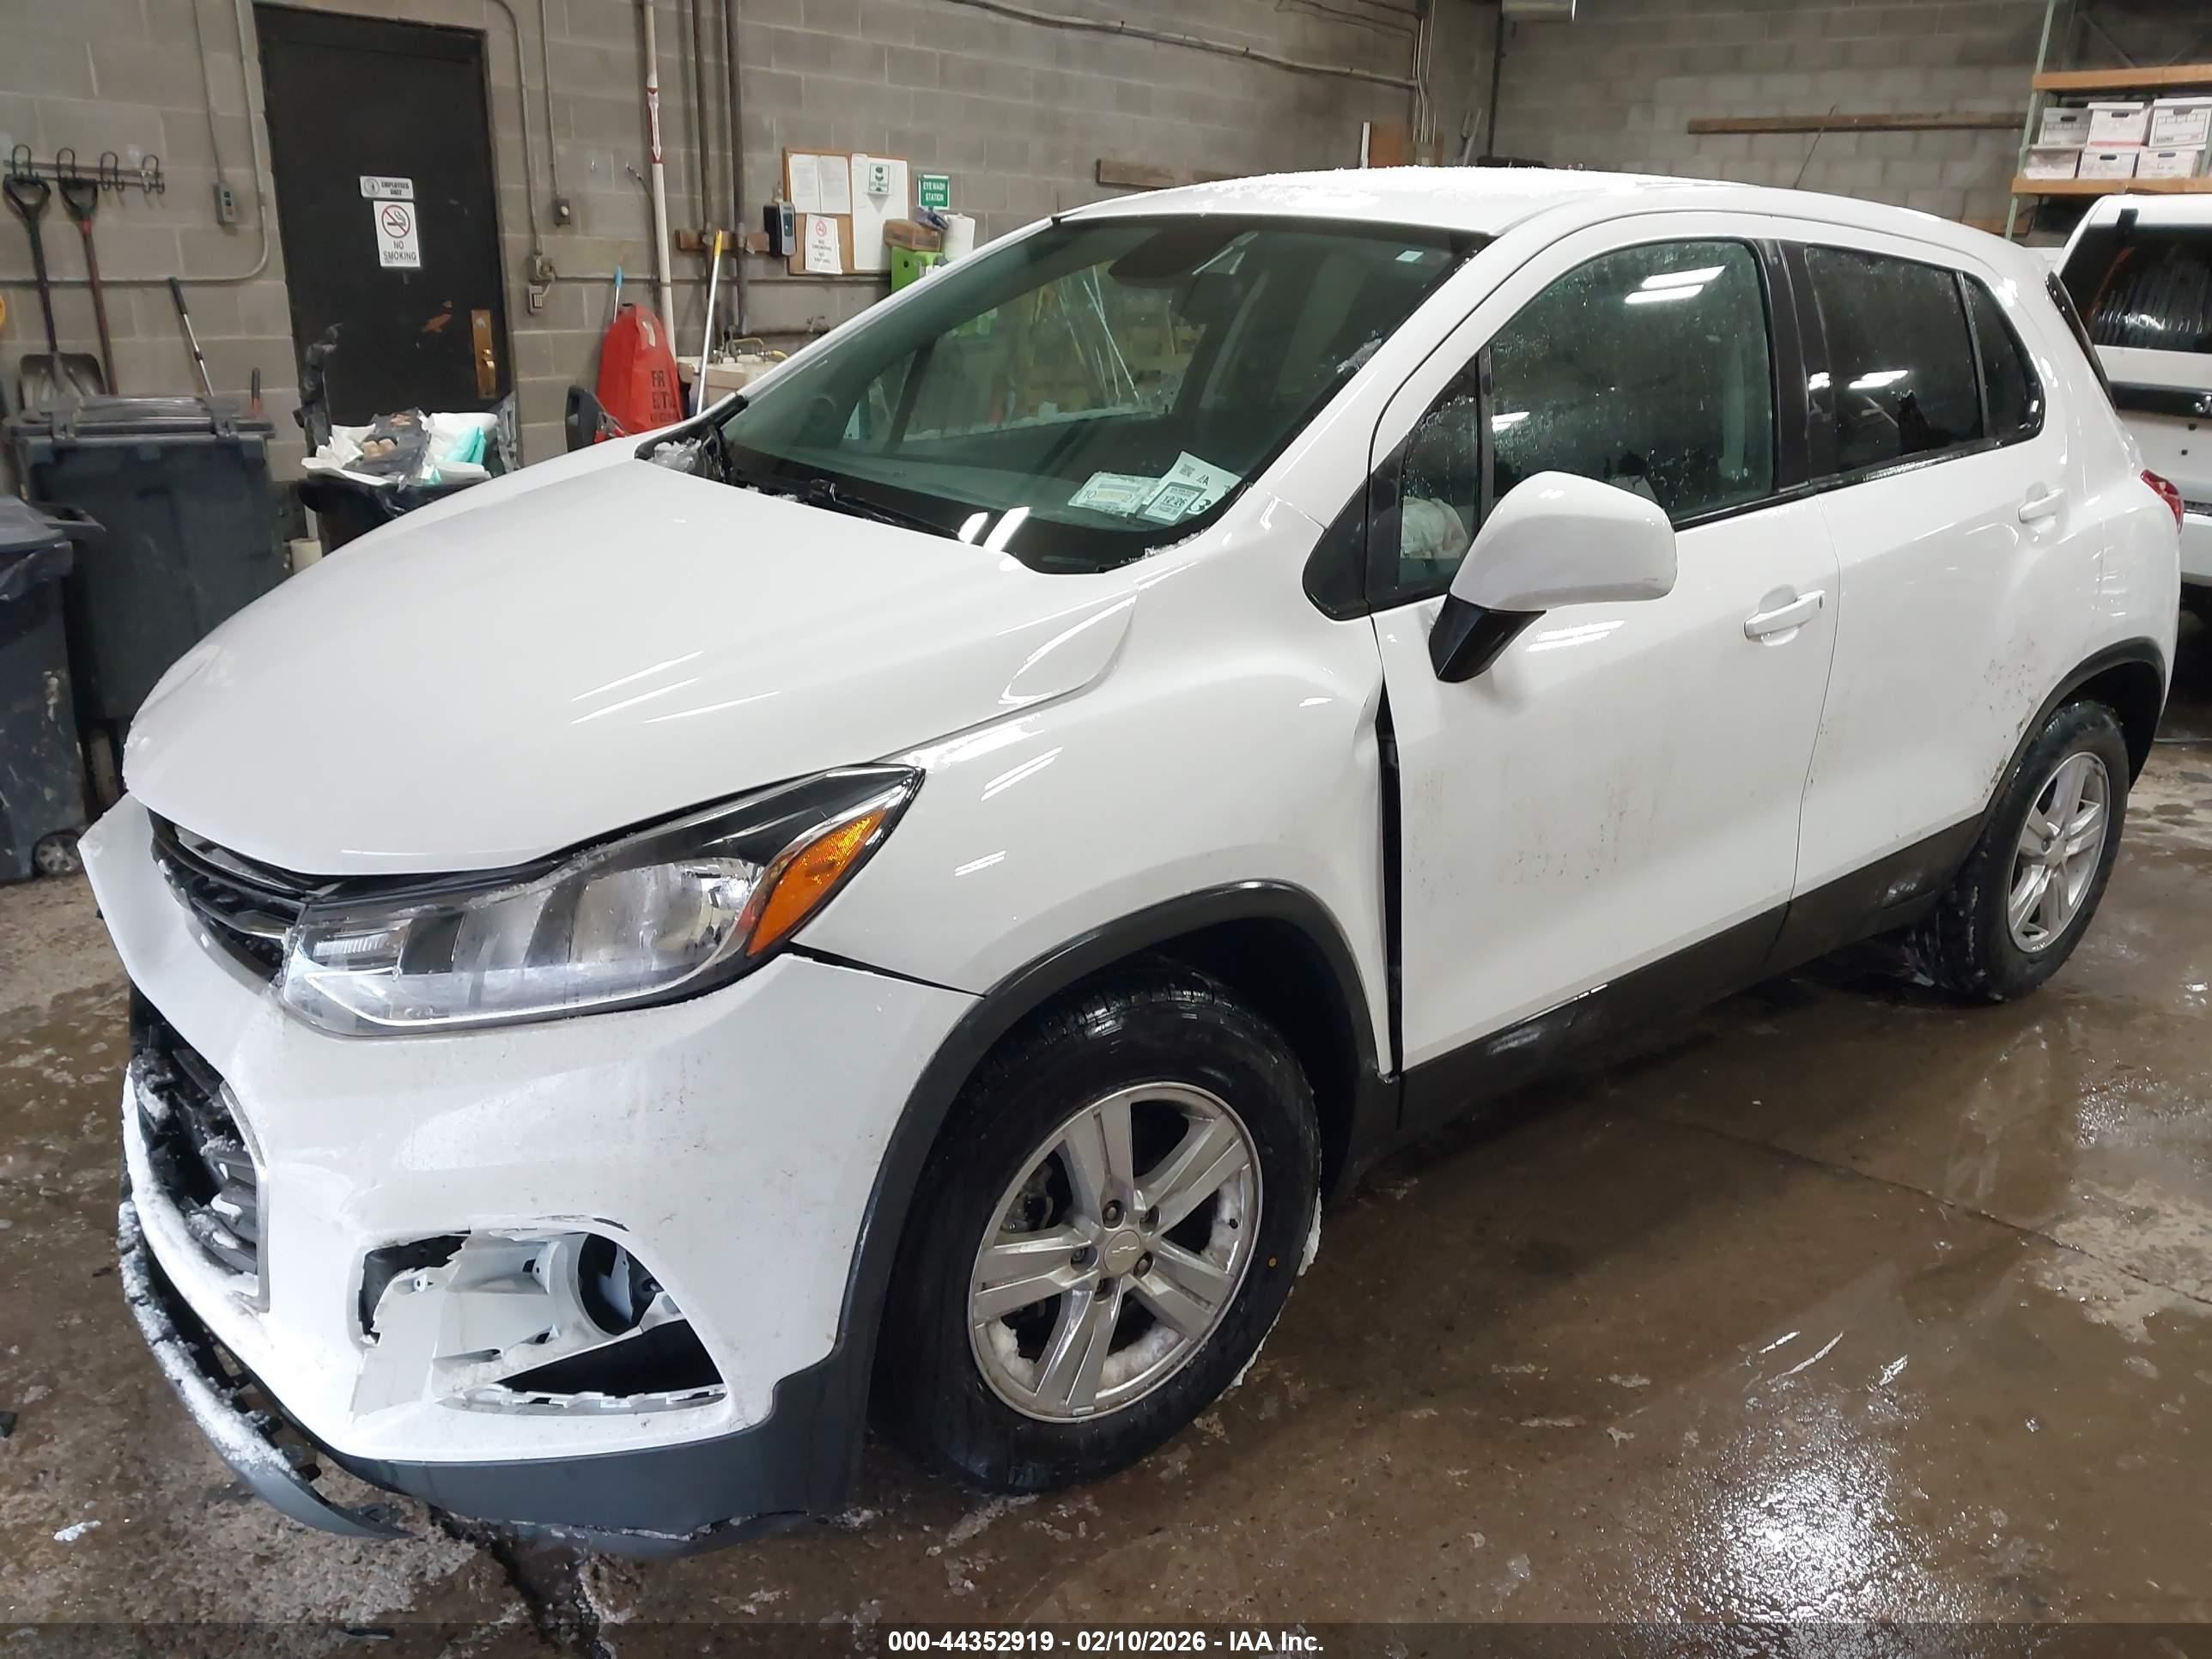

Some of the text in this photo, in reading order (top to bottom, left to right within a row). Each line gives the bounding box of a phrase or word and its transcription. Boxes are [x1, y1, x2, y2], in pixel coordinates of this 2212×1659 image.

[923, 181, 933, 191] EYE
[925, 192, 945, 202] STATION
[393, 240, 404, 250] NO
[383, 251, 416, 261] SMOKING
